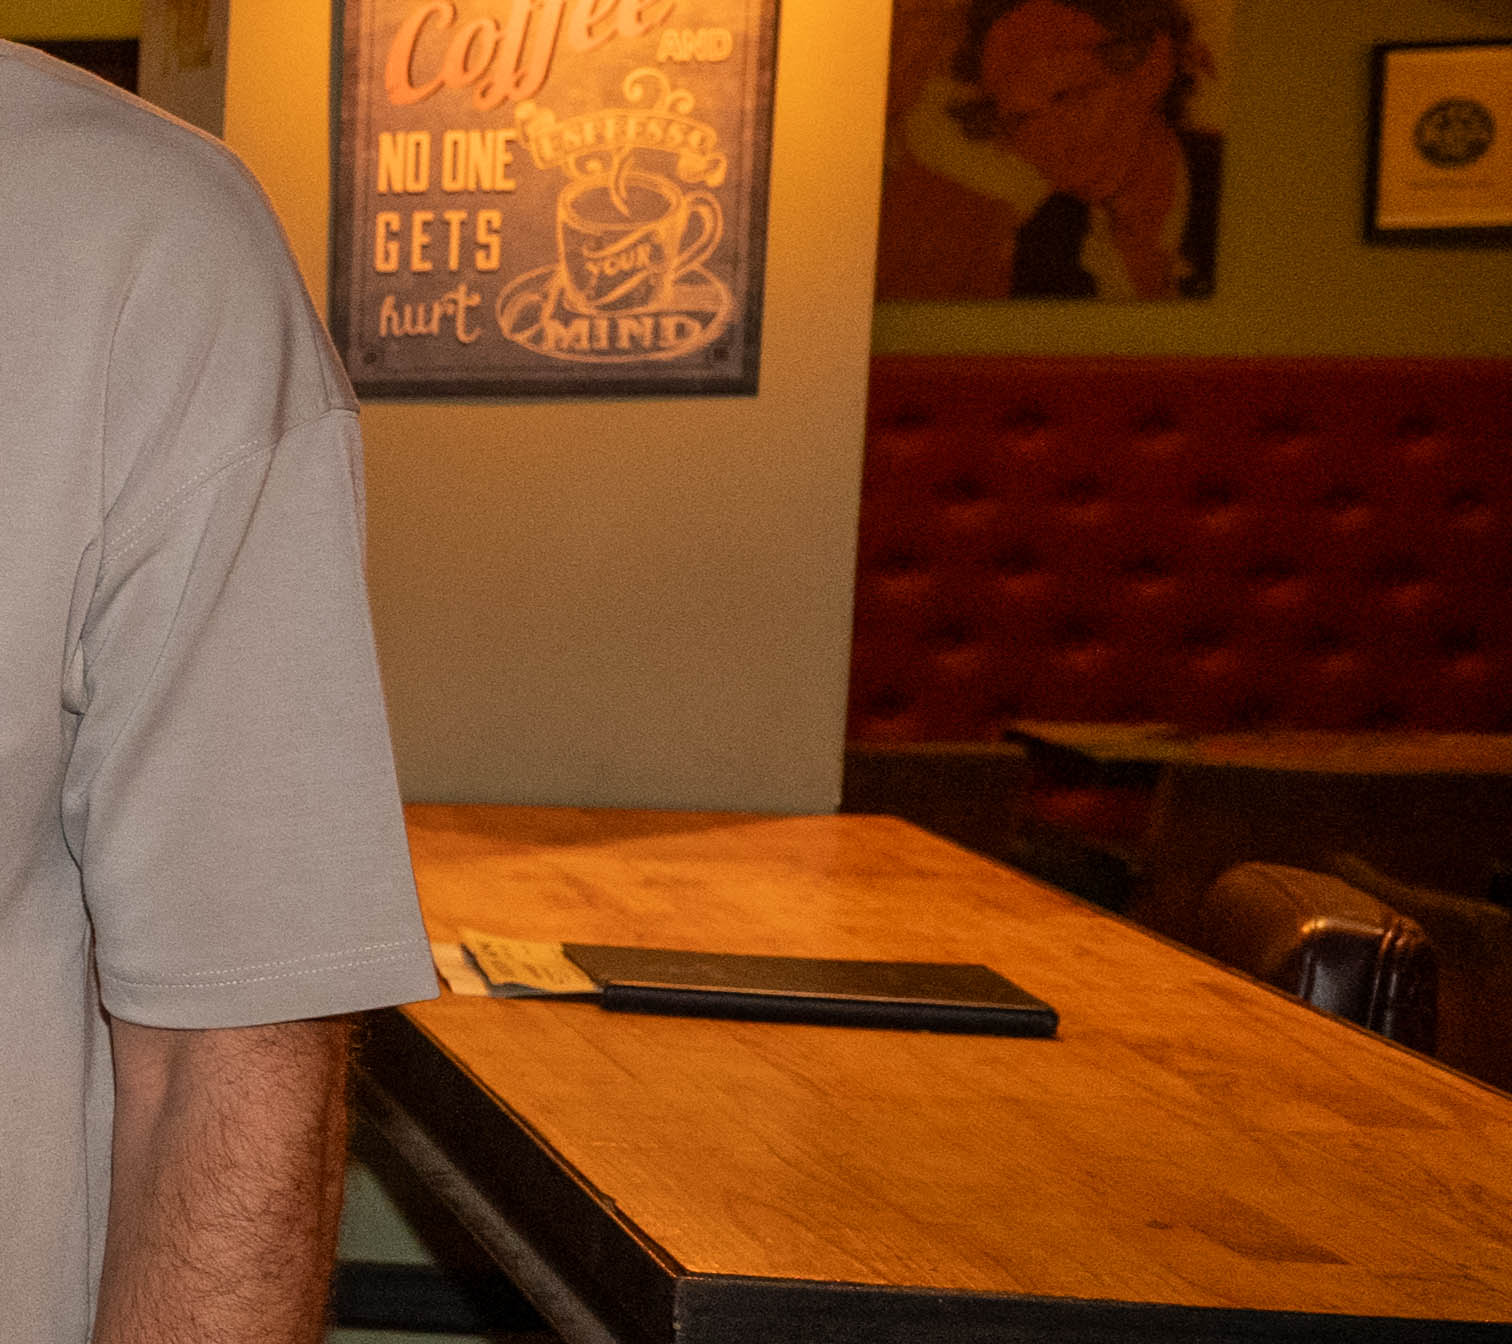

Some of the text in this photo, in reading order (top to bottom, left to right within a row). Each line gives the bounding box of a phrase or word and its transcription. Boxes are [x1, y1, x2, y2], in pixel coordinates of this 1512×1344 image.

[656, 26, 733, 63] AND
[377, 128, 517, 196] NO ONE
[374, 208, 503, 274] GETS
[378, 283, 483, 346] hurt
[544, 317, 702, 351] MIND
